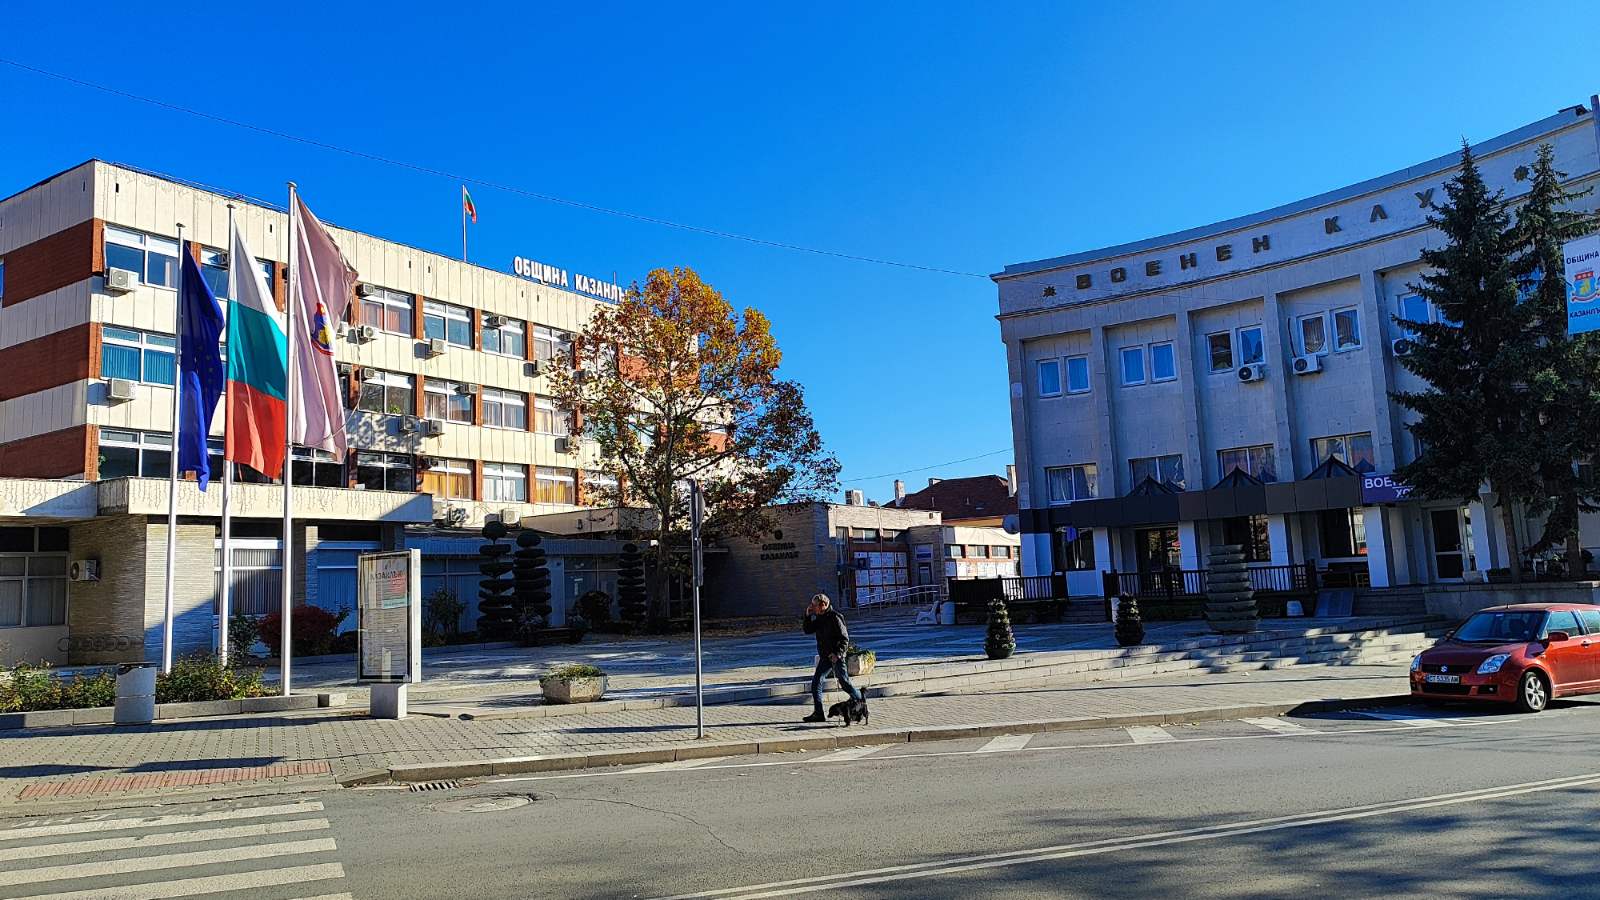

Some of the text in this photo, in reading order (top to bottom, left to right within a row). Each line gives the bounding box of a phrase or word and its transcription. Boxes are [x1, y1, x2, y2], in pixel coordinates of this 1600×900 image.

[1076, 188, 1434, 289] ВОЕНЕН КЛУ
[1566, 250, 1600, 265] ОБЩИНА
[513, 256, 628, 305] ОБЩИНА КАЗАНЛЪ
